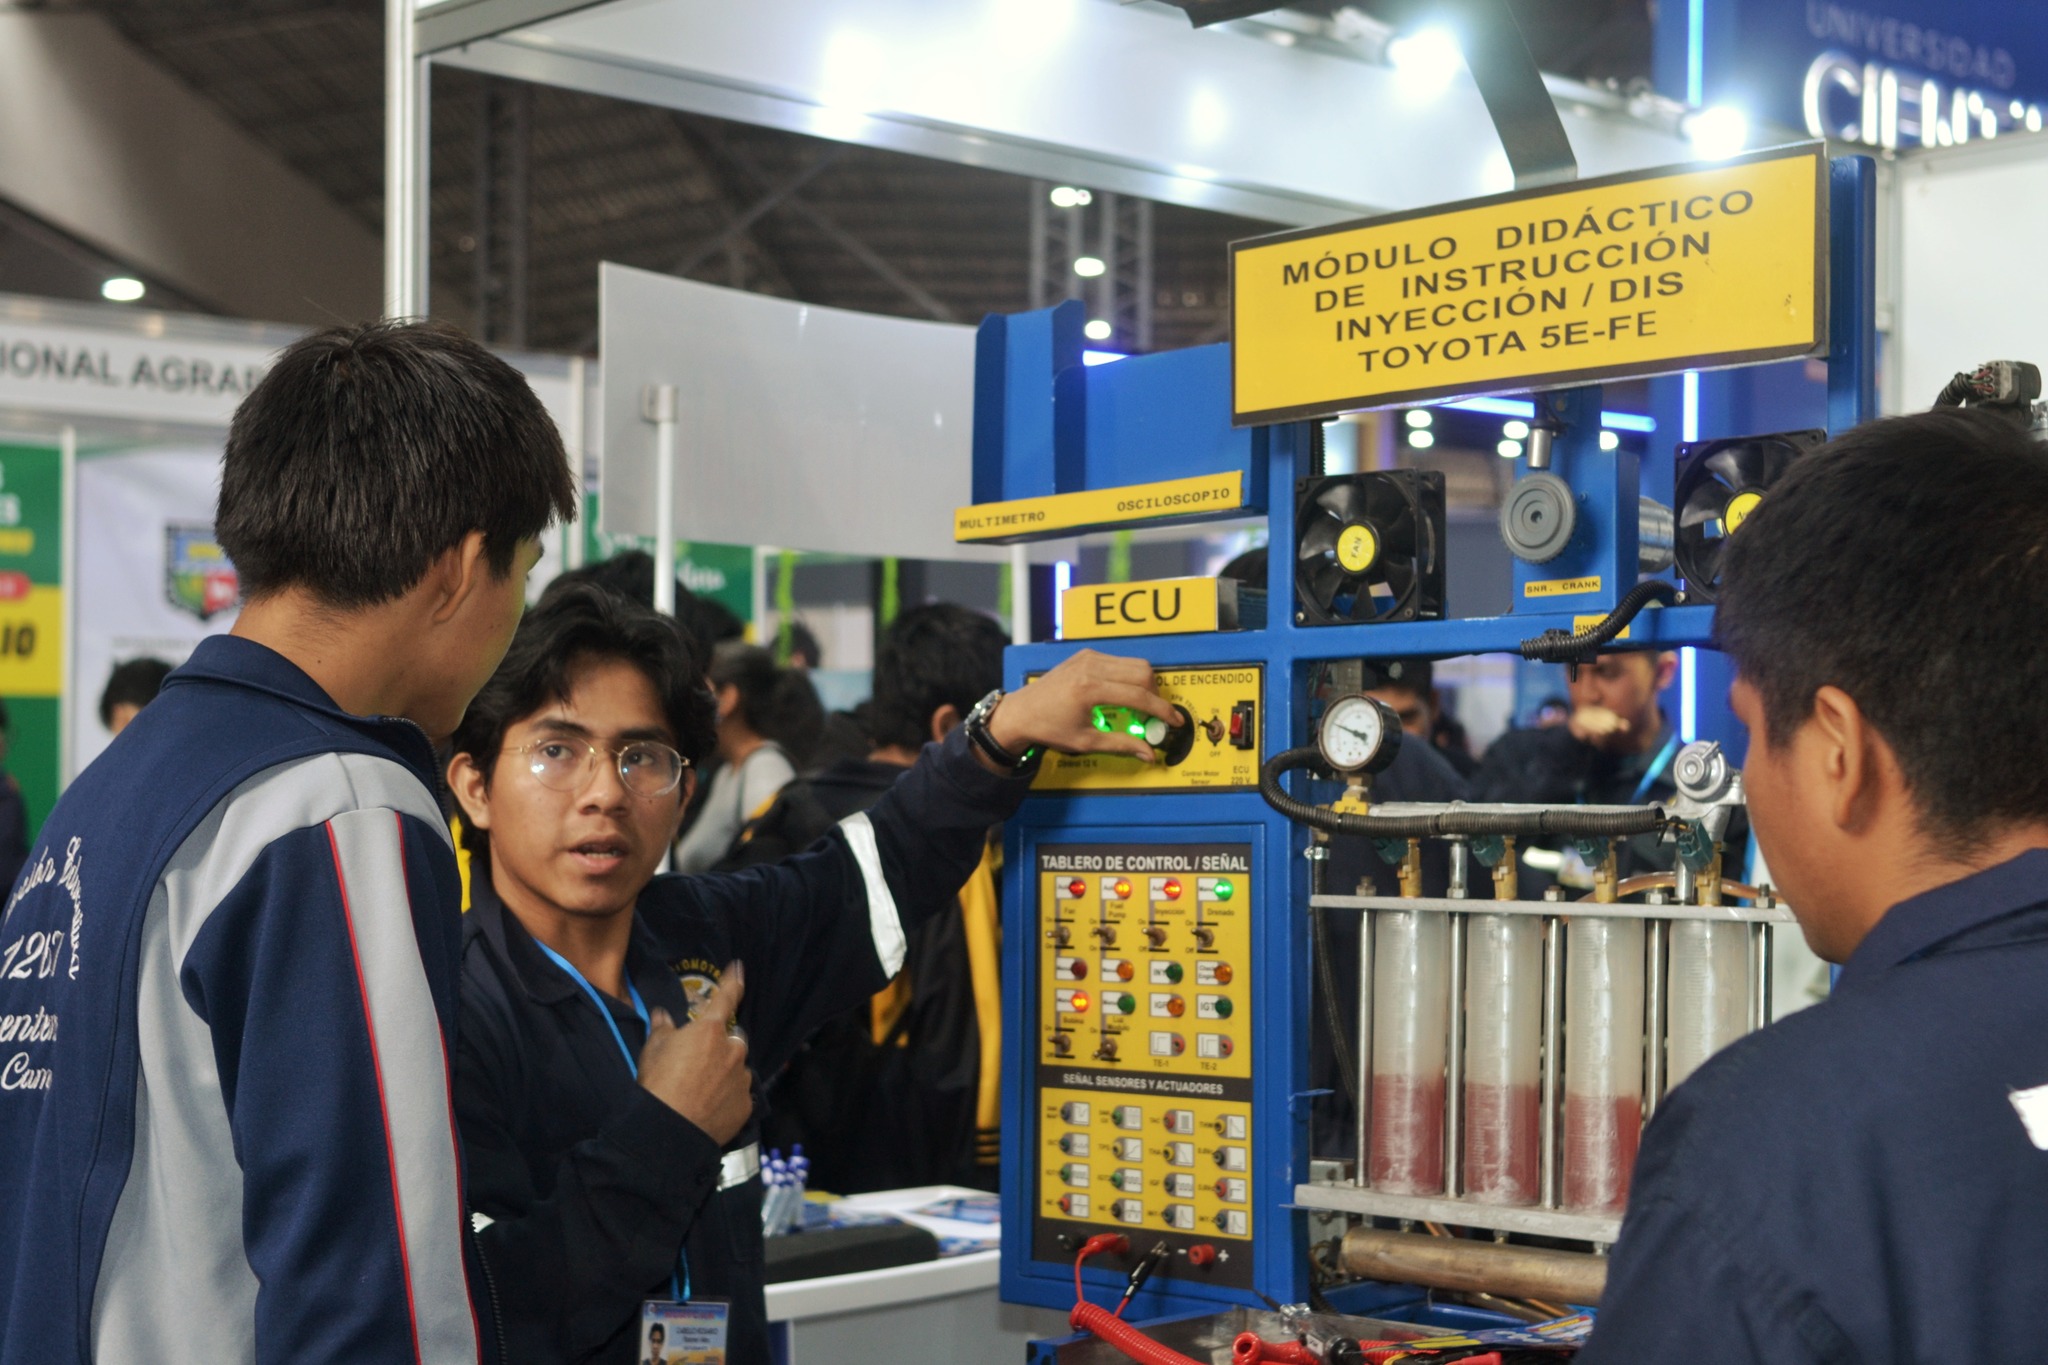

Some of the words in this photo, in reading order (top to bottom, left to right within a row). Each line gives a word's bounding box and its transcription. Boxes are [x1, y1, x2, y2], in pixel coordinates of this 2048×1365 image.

[1282, 236, 1458, 287] MÓDULO
[1496, 190, 1754, 251] DIDÁCTICO
[1314, 284, 1366, 313] DE
[1401, 230, 1711, 300] INSTRUCCIÓN
[1336, 285, 1568, 343] INYECCIÓN
[1609, 271, 1684, 304] DIS
[1358, 330, 1528, 373] TOYOTA
[1540, 310, 1658, 350] 5E-FE
[1117, 487, 1230, 512] OSCILOSCOPIO
[959, 511, 1045, 531] MULTIMETRO
[1562, 580, 1600, 591] CRANK
[1095, 587, 1182, 625] ECU
[1173, 675, 1187, 686] DE
[1190, 672, 1254, 685] ENCENDIDO
[1233, 765, 1249, 774] ECU
[1042, 855, 1102, 870] TABLERO
[1105, 856, 1123, 870] DE
[1126, 856, 1192, 870] CONTROL
[1201, 853, 1248, 871] SEÑAL
[1063, 1073, 1093, 1085] SEÑAL
[1096, 1075, 1147, 1089] SENSORES
[1149, 1079, 1156, 1089] Y
[1156, 1079, 1223, 1095] ACTUADORES
